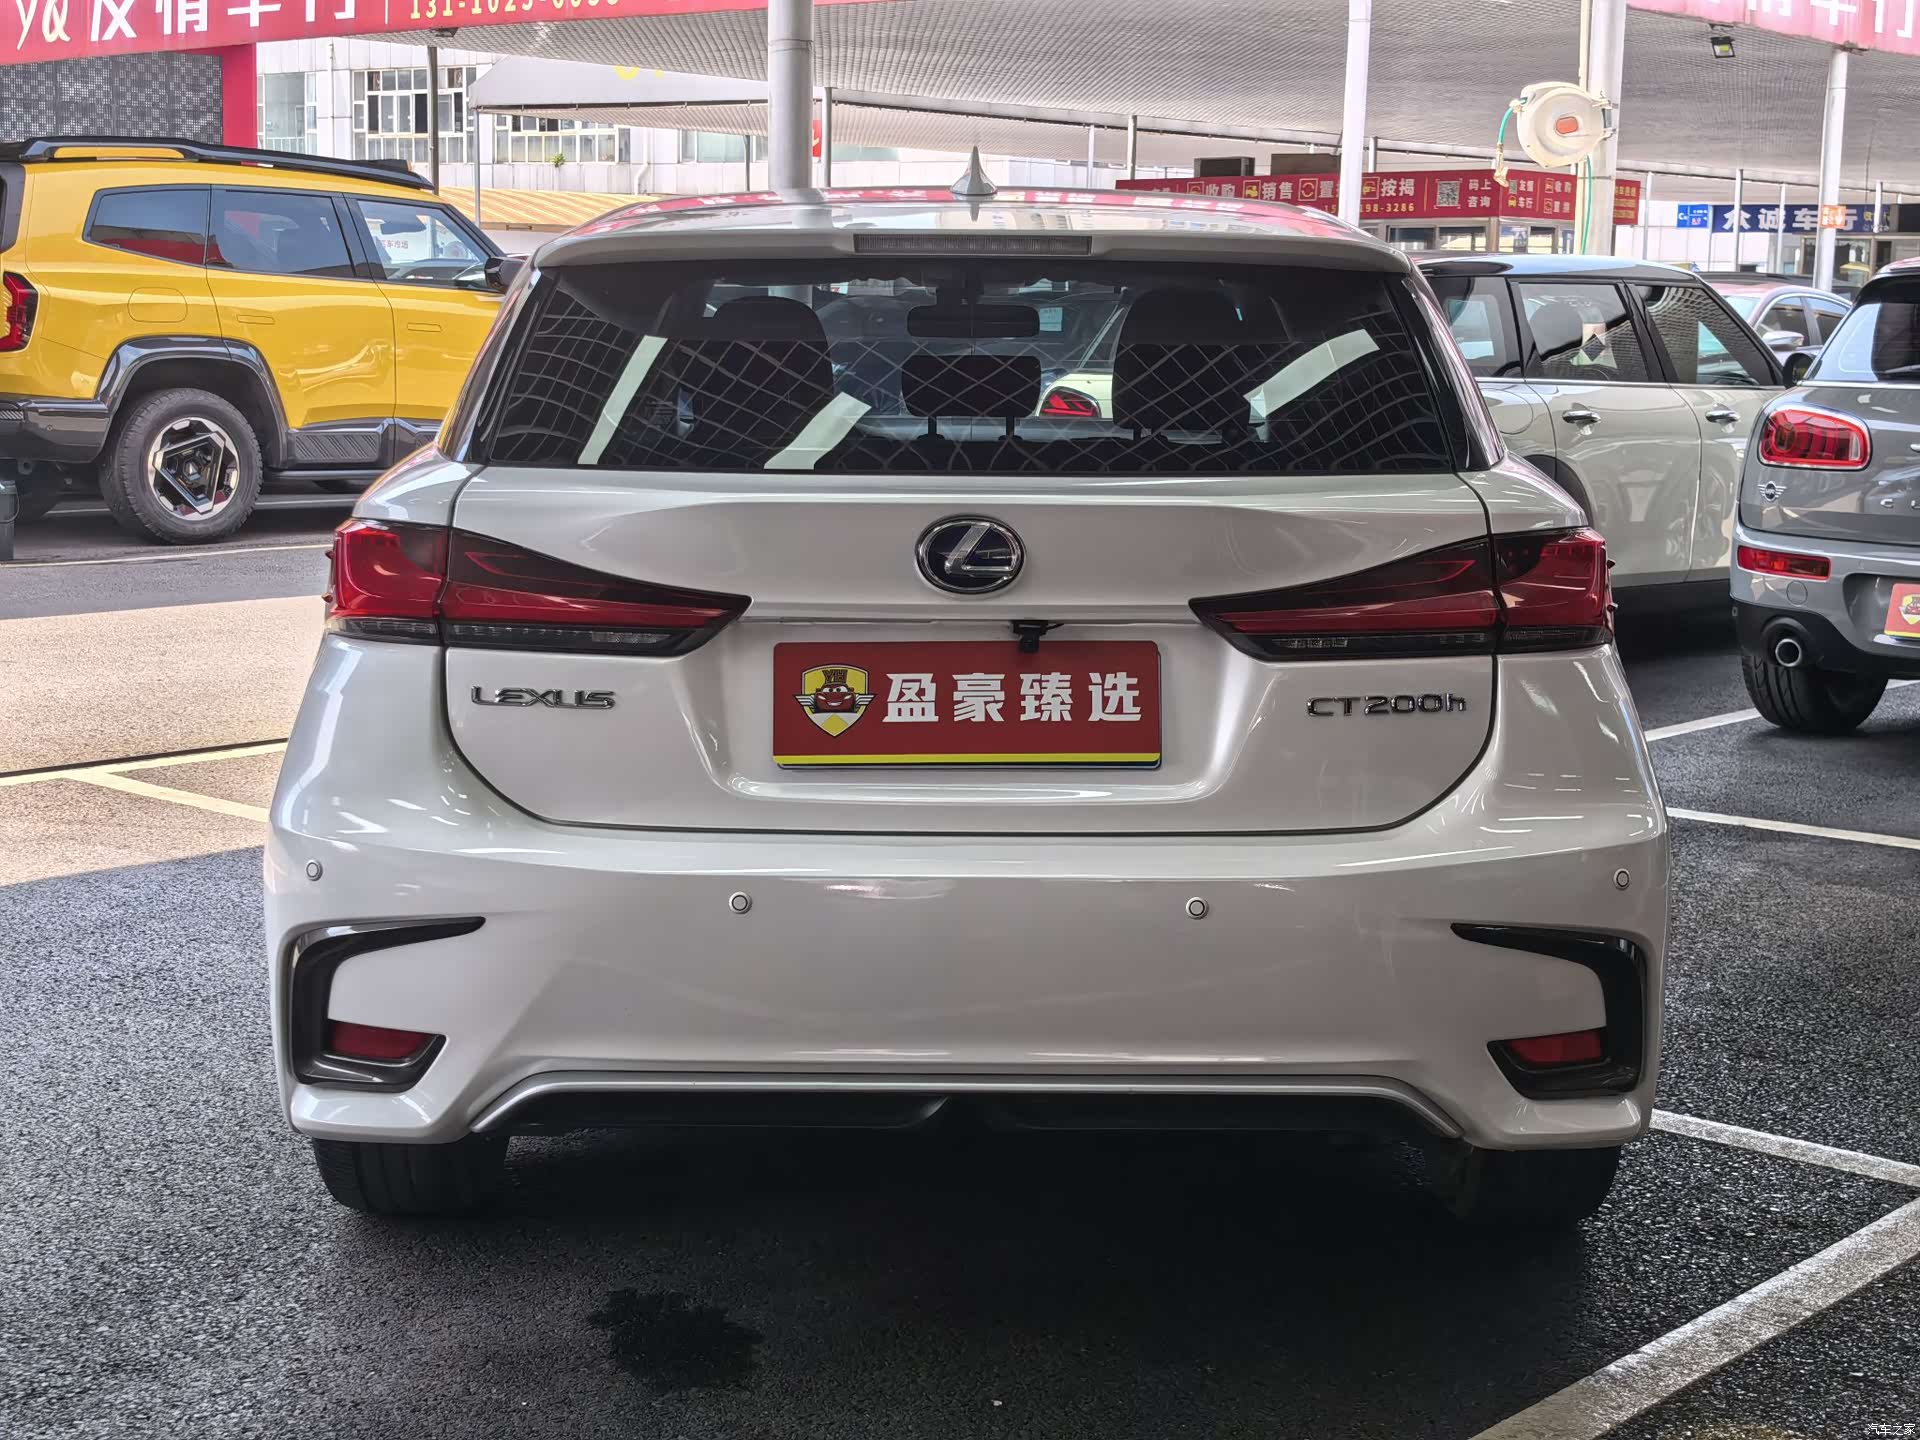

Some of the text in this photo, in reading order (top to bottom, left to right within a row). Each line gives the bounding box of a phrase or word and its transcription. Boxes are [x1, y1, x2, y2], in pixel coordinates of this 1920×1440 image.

[1262, 181, 1293, 200] 销售
[1381, 177, 1415, 197] 按揭
[471, 685, 616, 709] LEXUS
[882, 672, 1142, 723] 盈豪臻选
